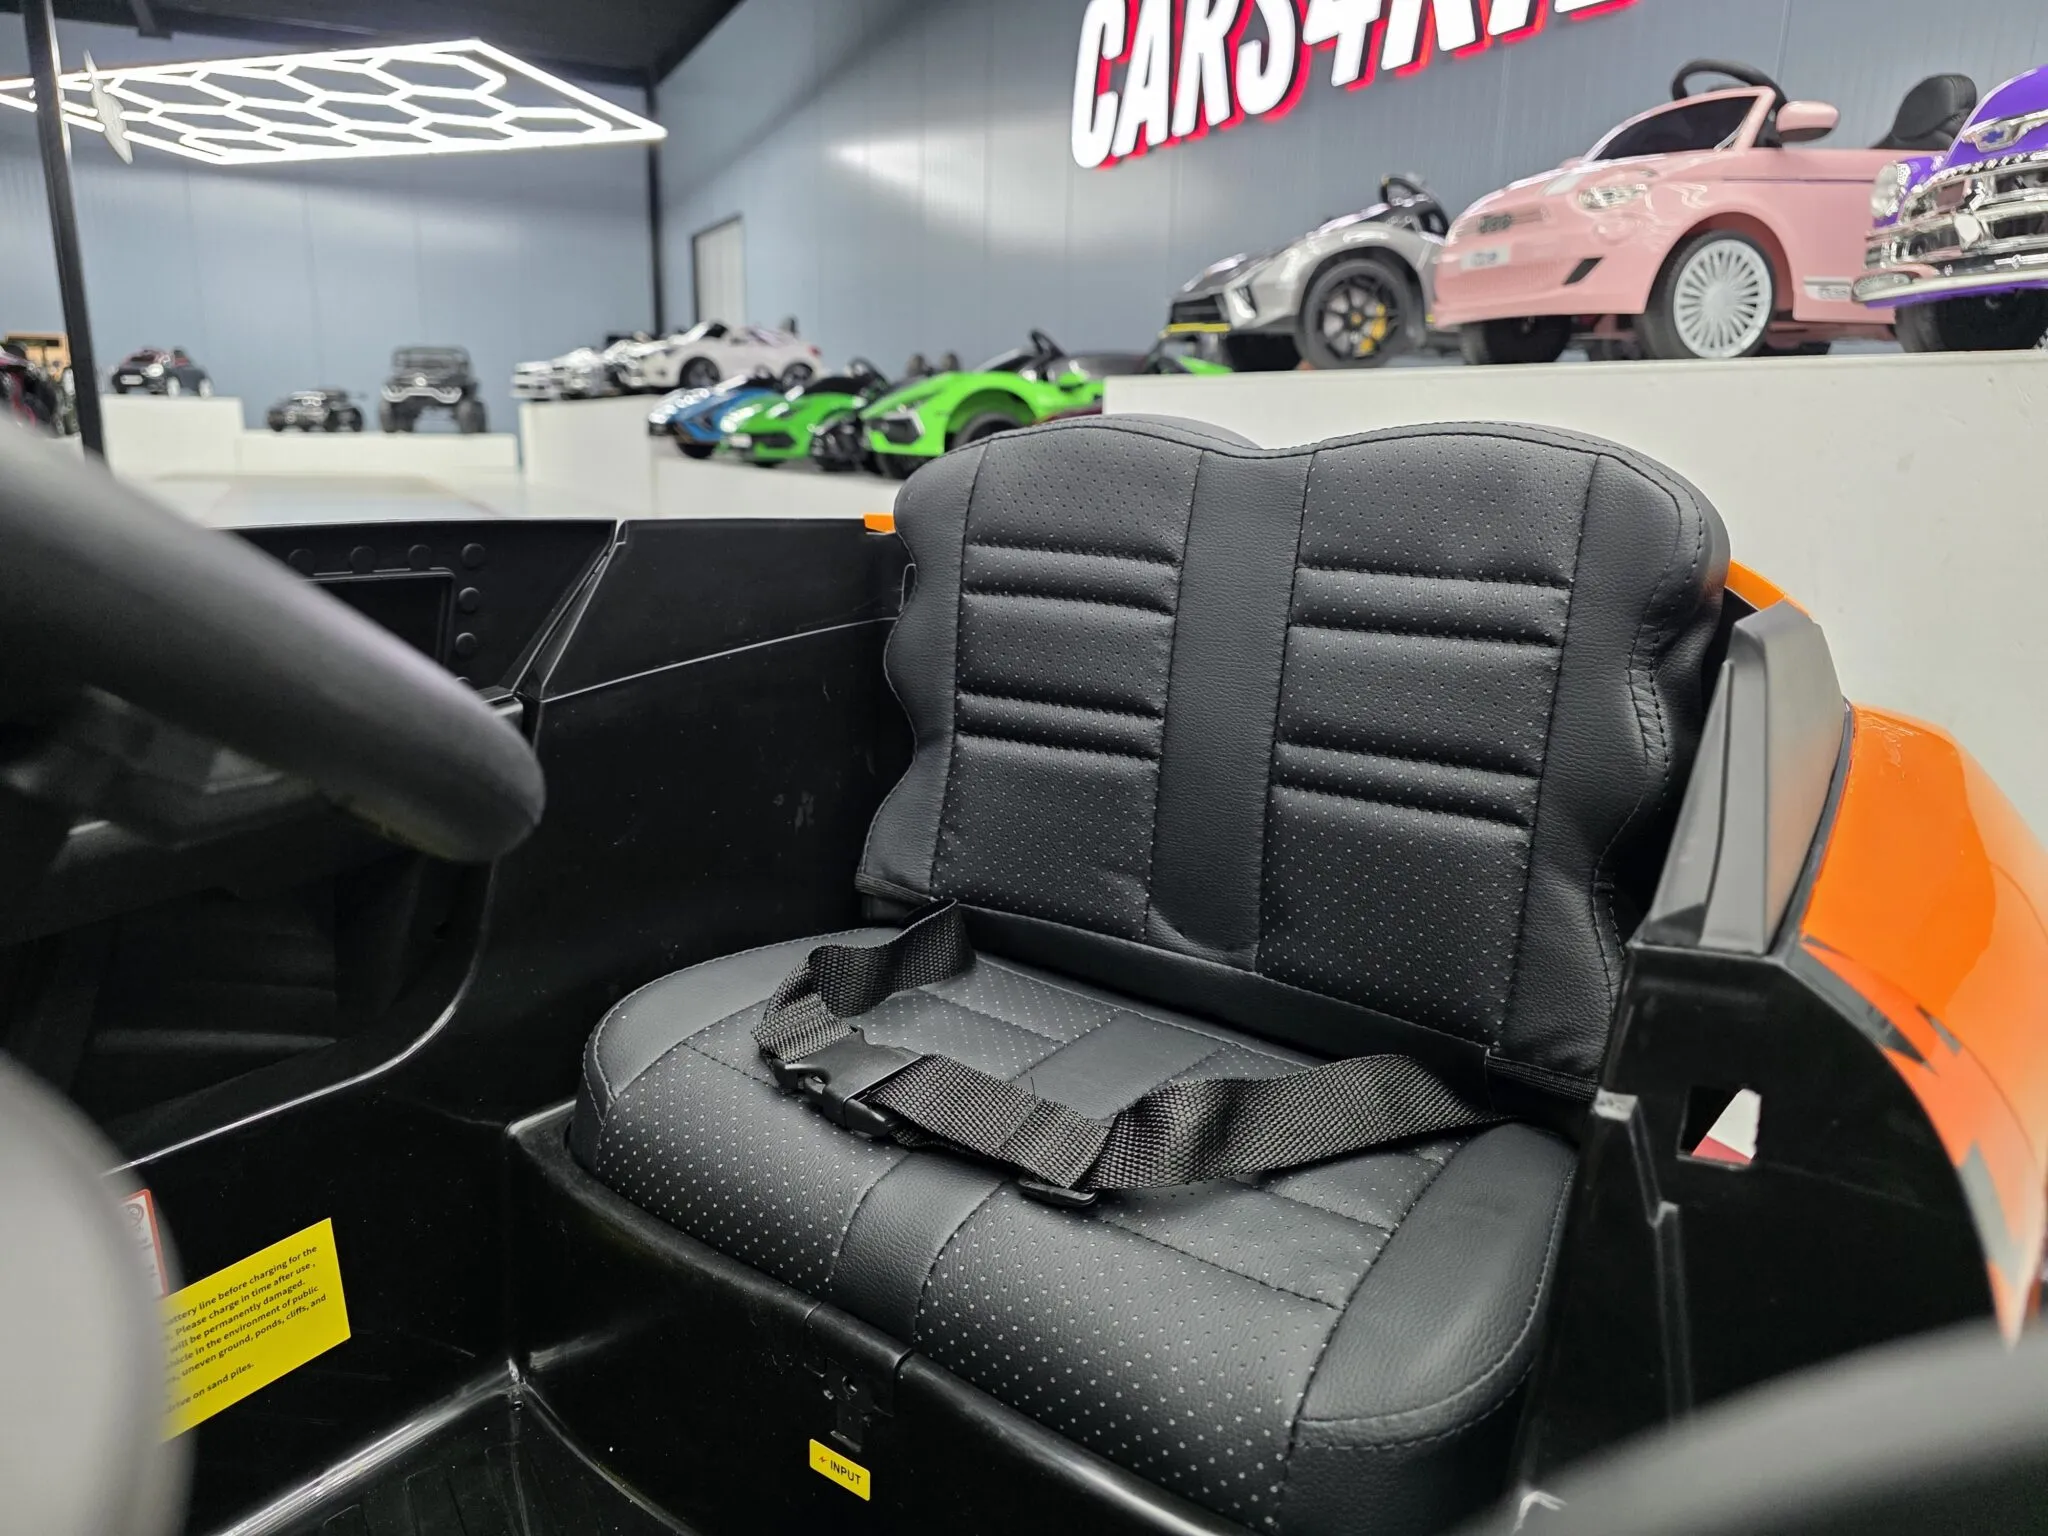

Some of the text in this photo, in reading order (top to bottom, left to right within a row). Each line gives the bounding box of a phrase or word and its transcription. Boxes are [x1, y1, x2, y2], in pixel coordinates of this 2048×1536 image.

[176, 1316, 207, 1335] Please
[209, 1299, 239, 1319] charge
[241, 1294, 250, 1303] in
[251, 1283, 272, 1297] time
[273, 1272, 294, 1286] after
[199, 1297, 216, 1310] line
[218, 1281, 248, 1300] before
[249, 1261, 288, 1284] charging
[289, 1253, 301, 1264] for
[303, 1246, 318, 1257] the
[181, 1294, 327, 1376] uneven ground, ponds, cliffs, and
[190, 1334, 202, 1344] be
[203, 1301, 261, 1338] permanently
[263, 1279, 306, 1305] damaged.
[196, 1345, 205, 1355] in
[206, 1337, 222, 1349] the
[223, 1306, 281, 1341] environment
[282, 1299, 292, 1309] of
[292, 1285, 319, 1305] public
[193, 1389, 205, 1399] on
[207, 1373, 229, 1391] sand
[230, 1362, 255, 1379] piles.
[830, 1459, 862, 1485] INPUT
